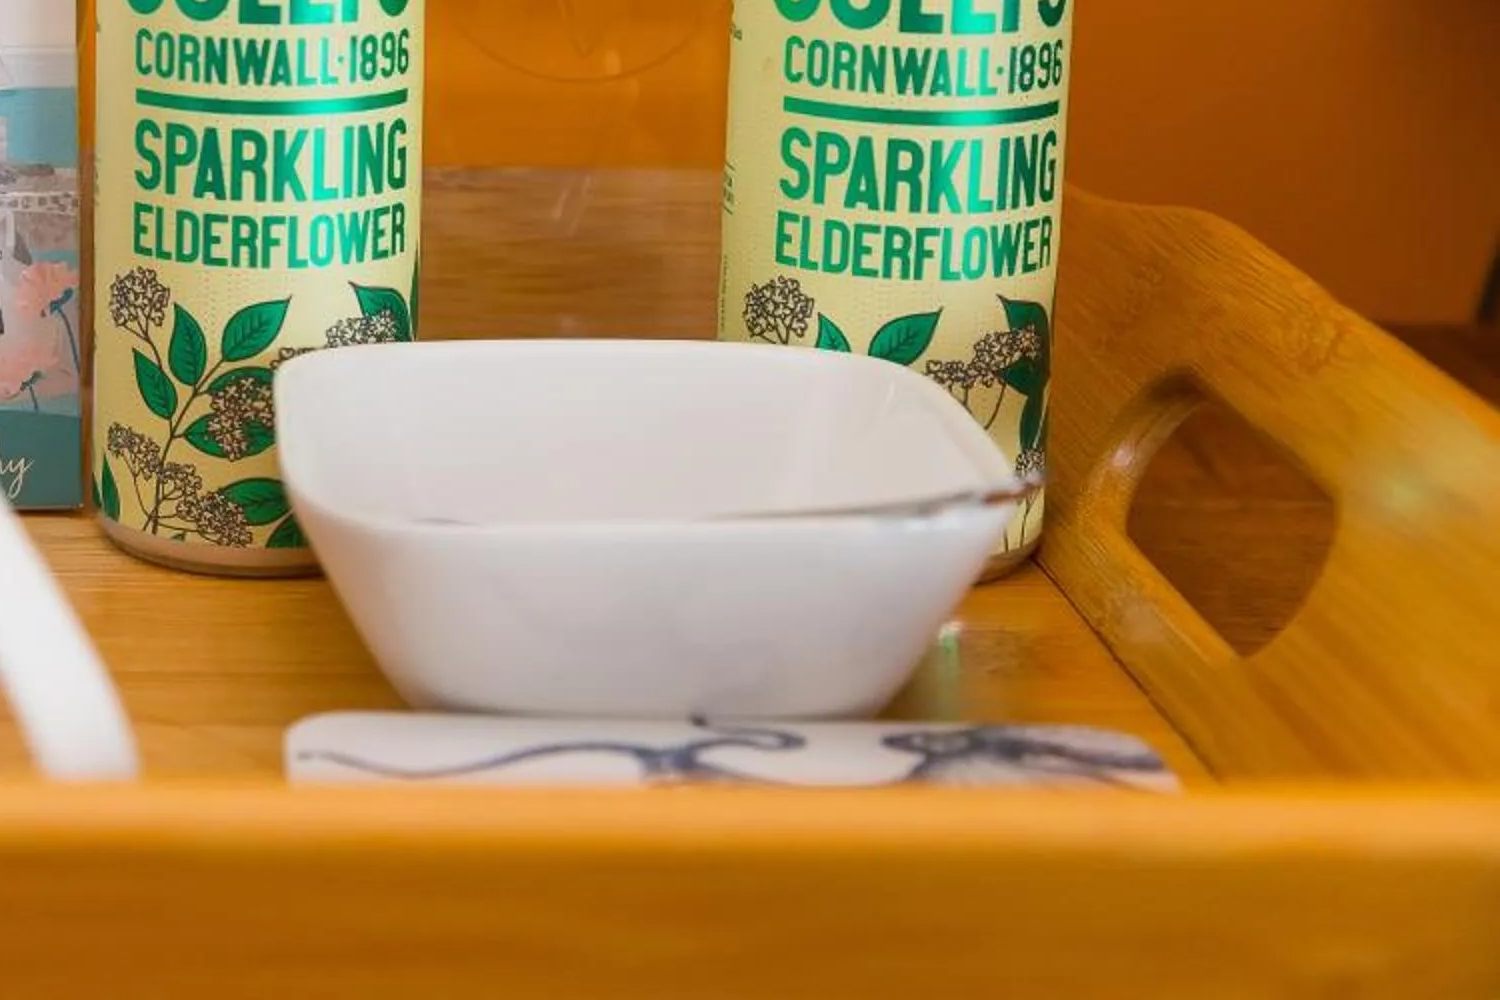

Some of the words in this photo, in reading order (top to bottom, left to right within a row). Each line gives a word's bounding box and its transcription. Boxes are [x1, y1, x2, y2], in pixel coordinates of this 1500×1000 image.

[135, 118, 408, 203] SPARKLING
[778, 126, 1058, 214] SPARKLING
[134, 201, 406, 269] ELDERFLOWER
[775, 210, 1053, 282] ELDERFLOWER
